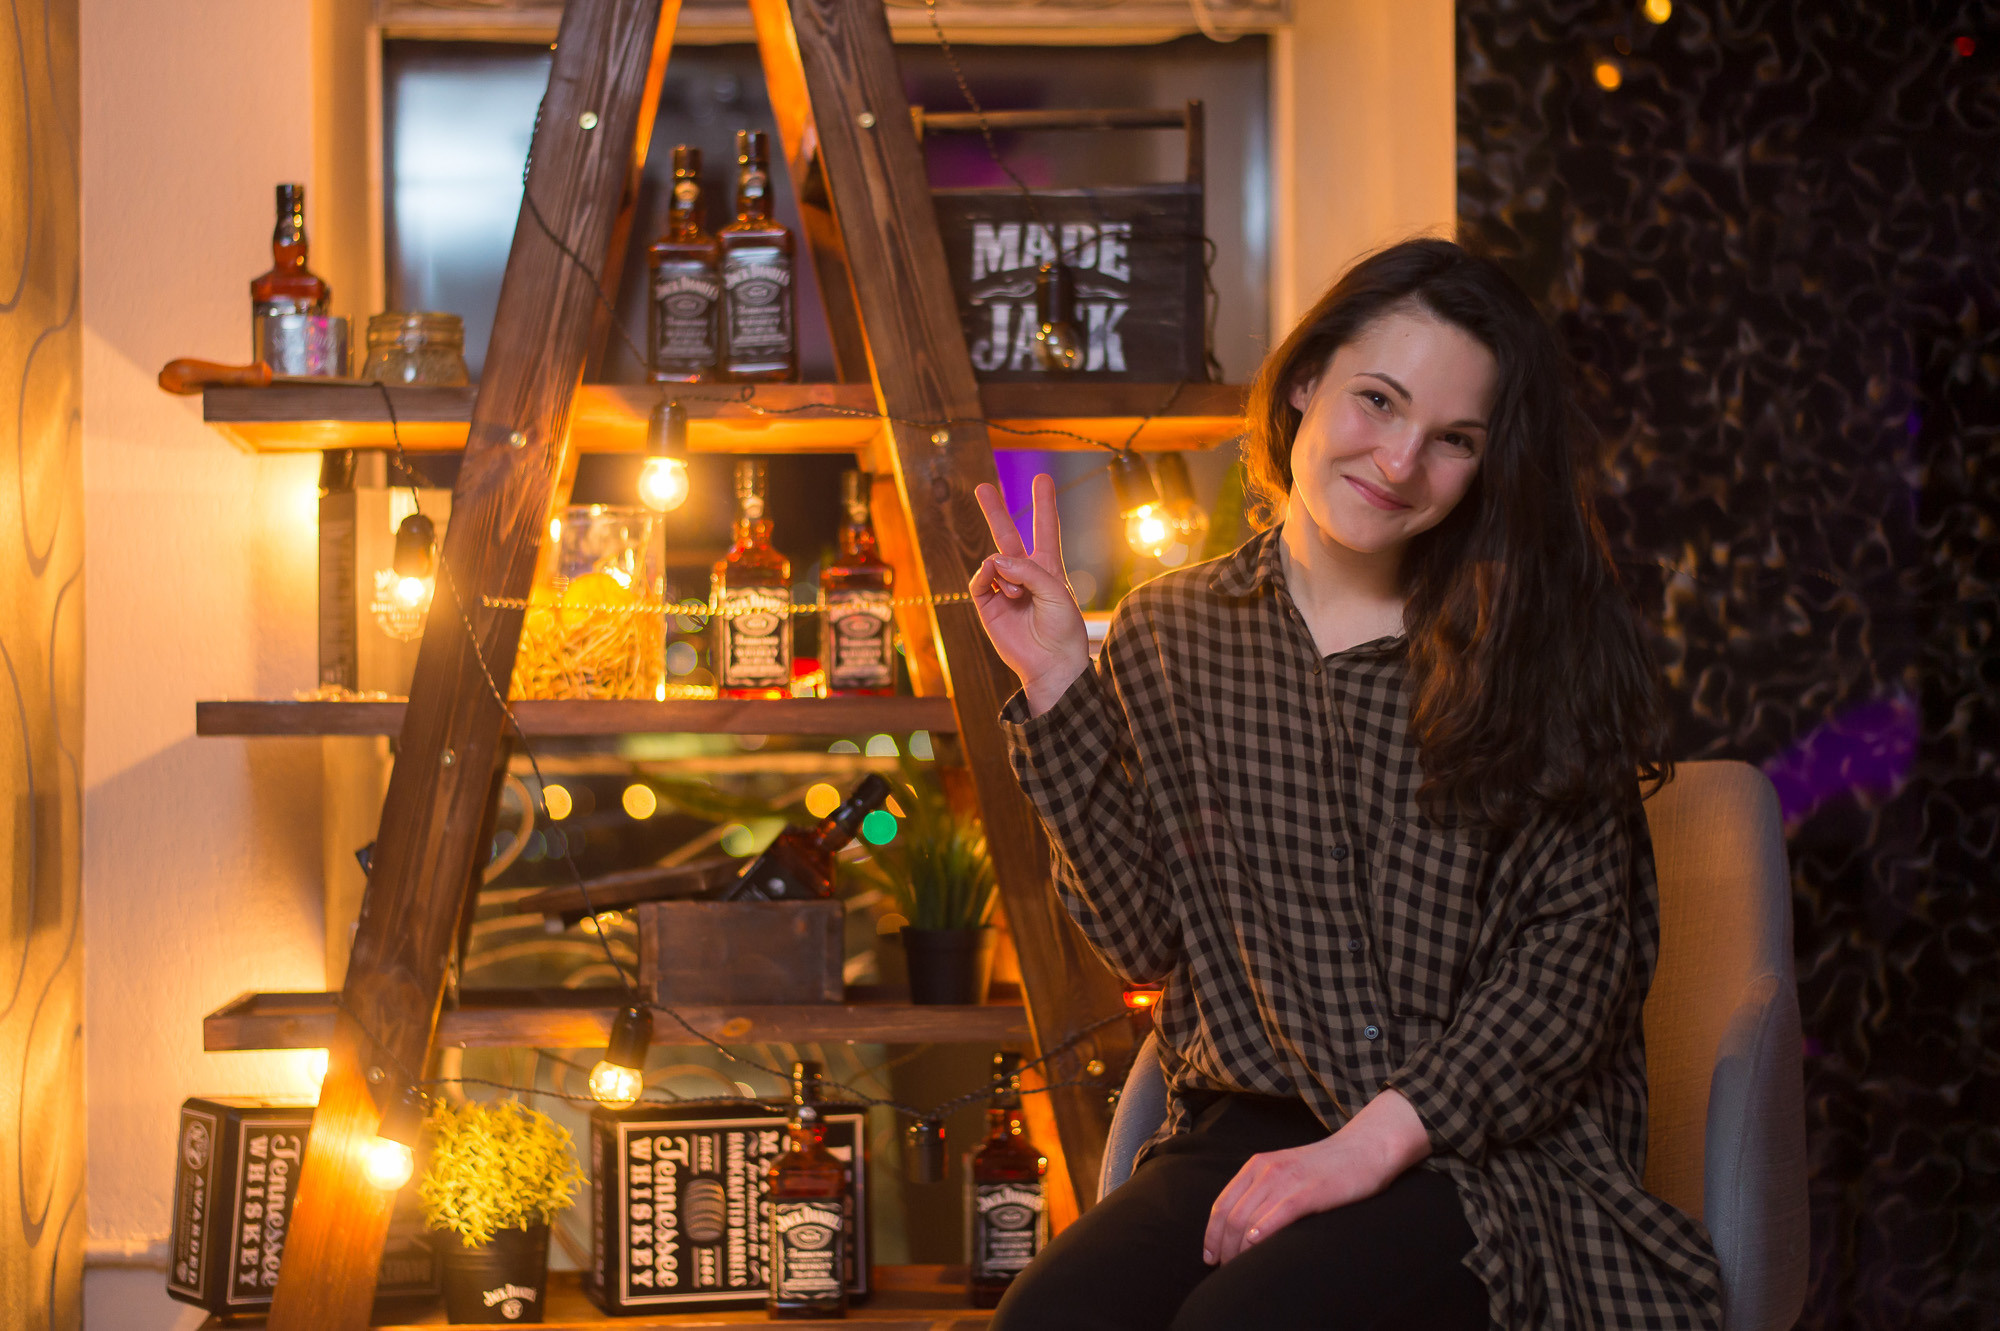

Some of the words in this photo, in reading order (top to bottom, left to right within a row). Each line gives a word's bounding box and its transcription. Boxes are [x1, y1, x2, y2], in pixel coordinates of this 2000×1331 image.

[971, 222, 1131, 283] MADE
[970, 303, 1129, 372] JAK
[187, 1174, 205, 1285] AWARDED
[239, 1135, 268, 1287] WHISKEY
[630, 1136, 654, 1288] WHISKEY
[653, 1136, 690, 1288] Tennessee
[727, 1132, 746, 1226] HANDCRAFTED
[727, 1228, 747, 1287] BARRELS
